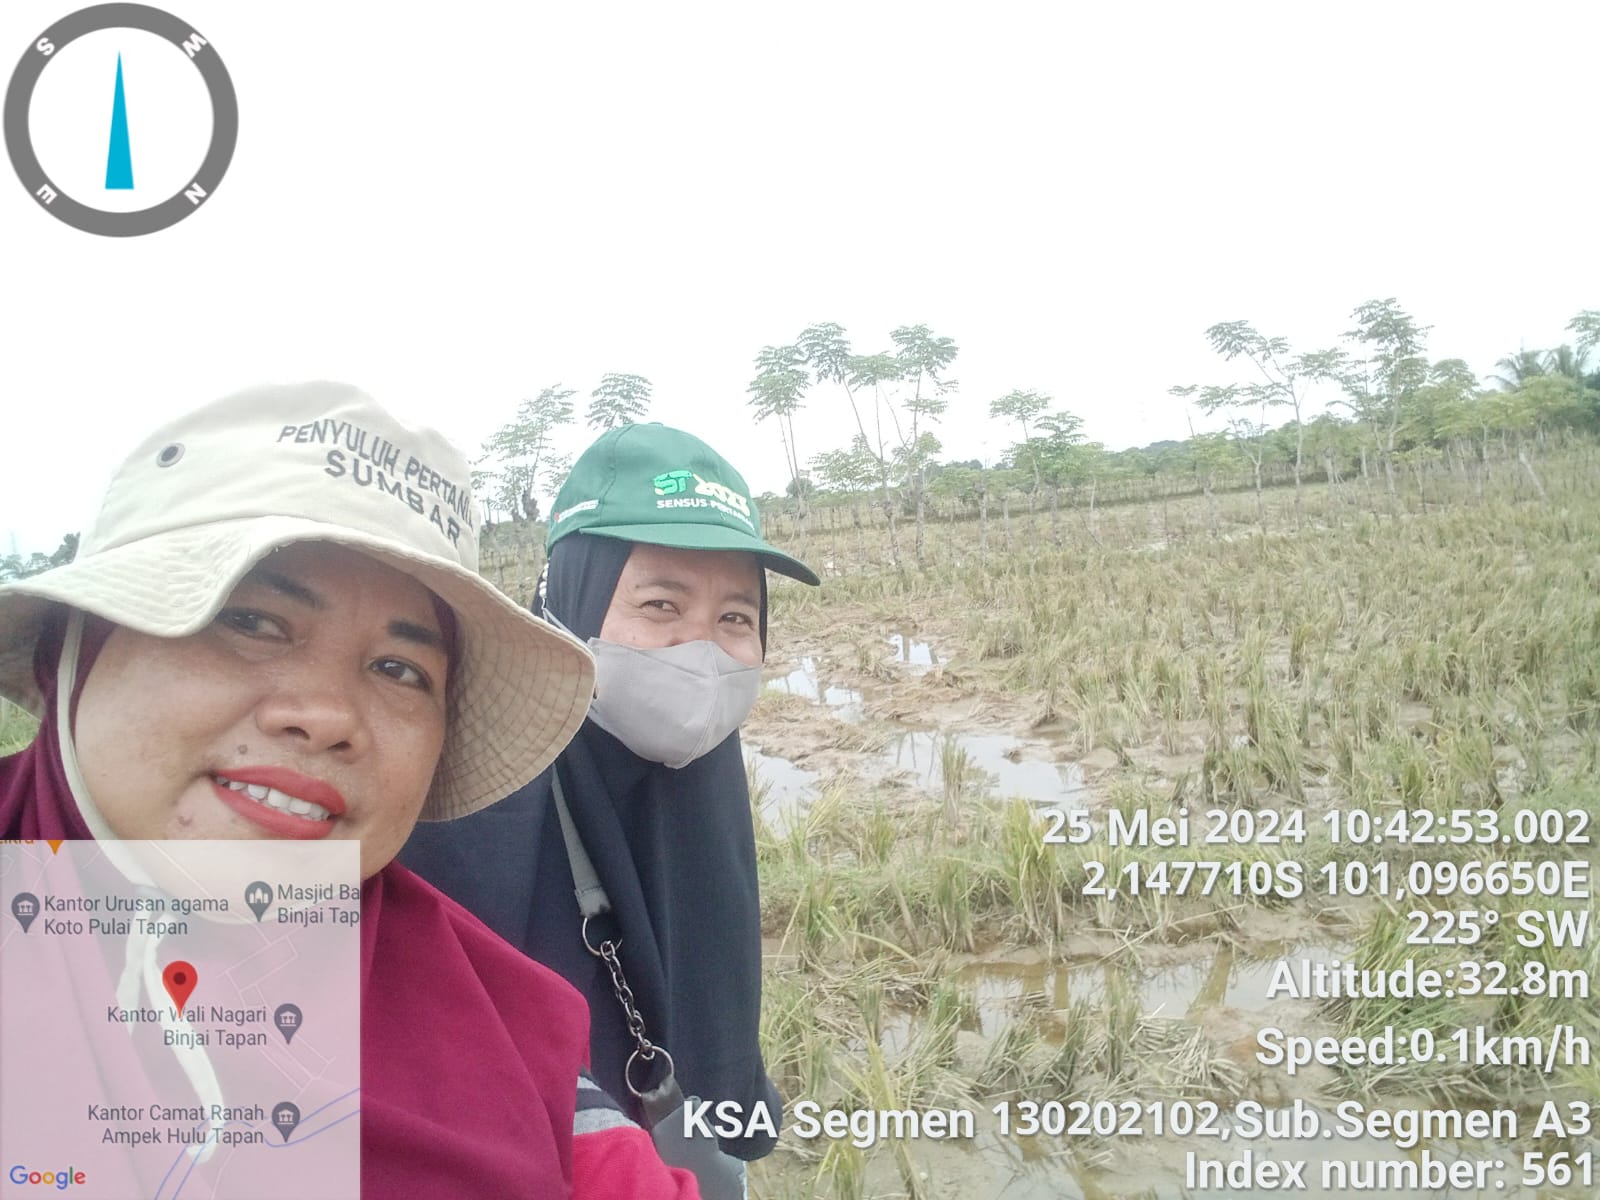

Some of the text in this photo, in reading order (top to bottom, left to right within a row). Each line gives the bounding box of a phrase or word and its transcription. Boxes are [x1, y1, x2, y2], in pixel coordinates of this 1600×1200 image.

[277, 418, 400, 477] PENYULUH
[325, 449, 460, 549] SUMBAR
[656, 498, 707, 509] SENSUS
